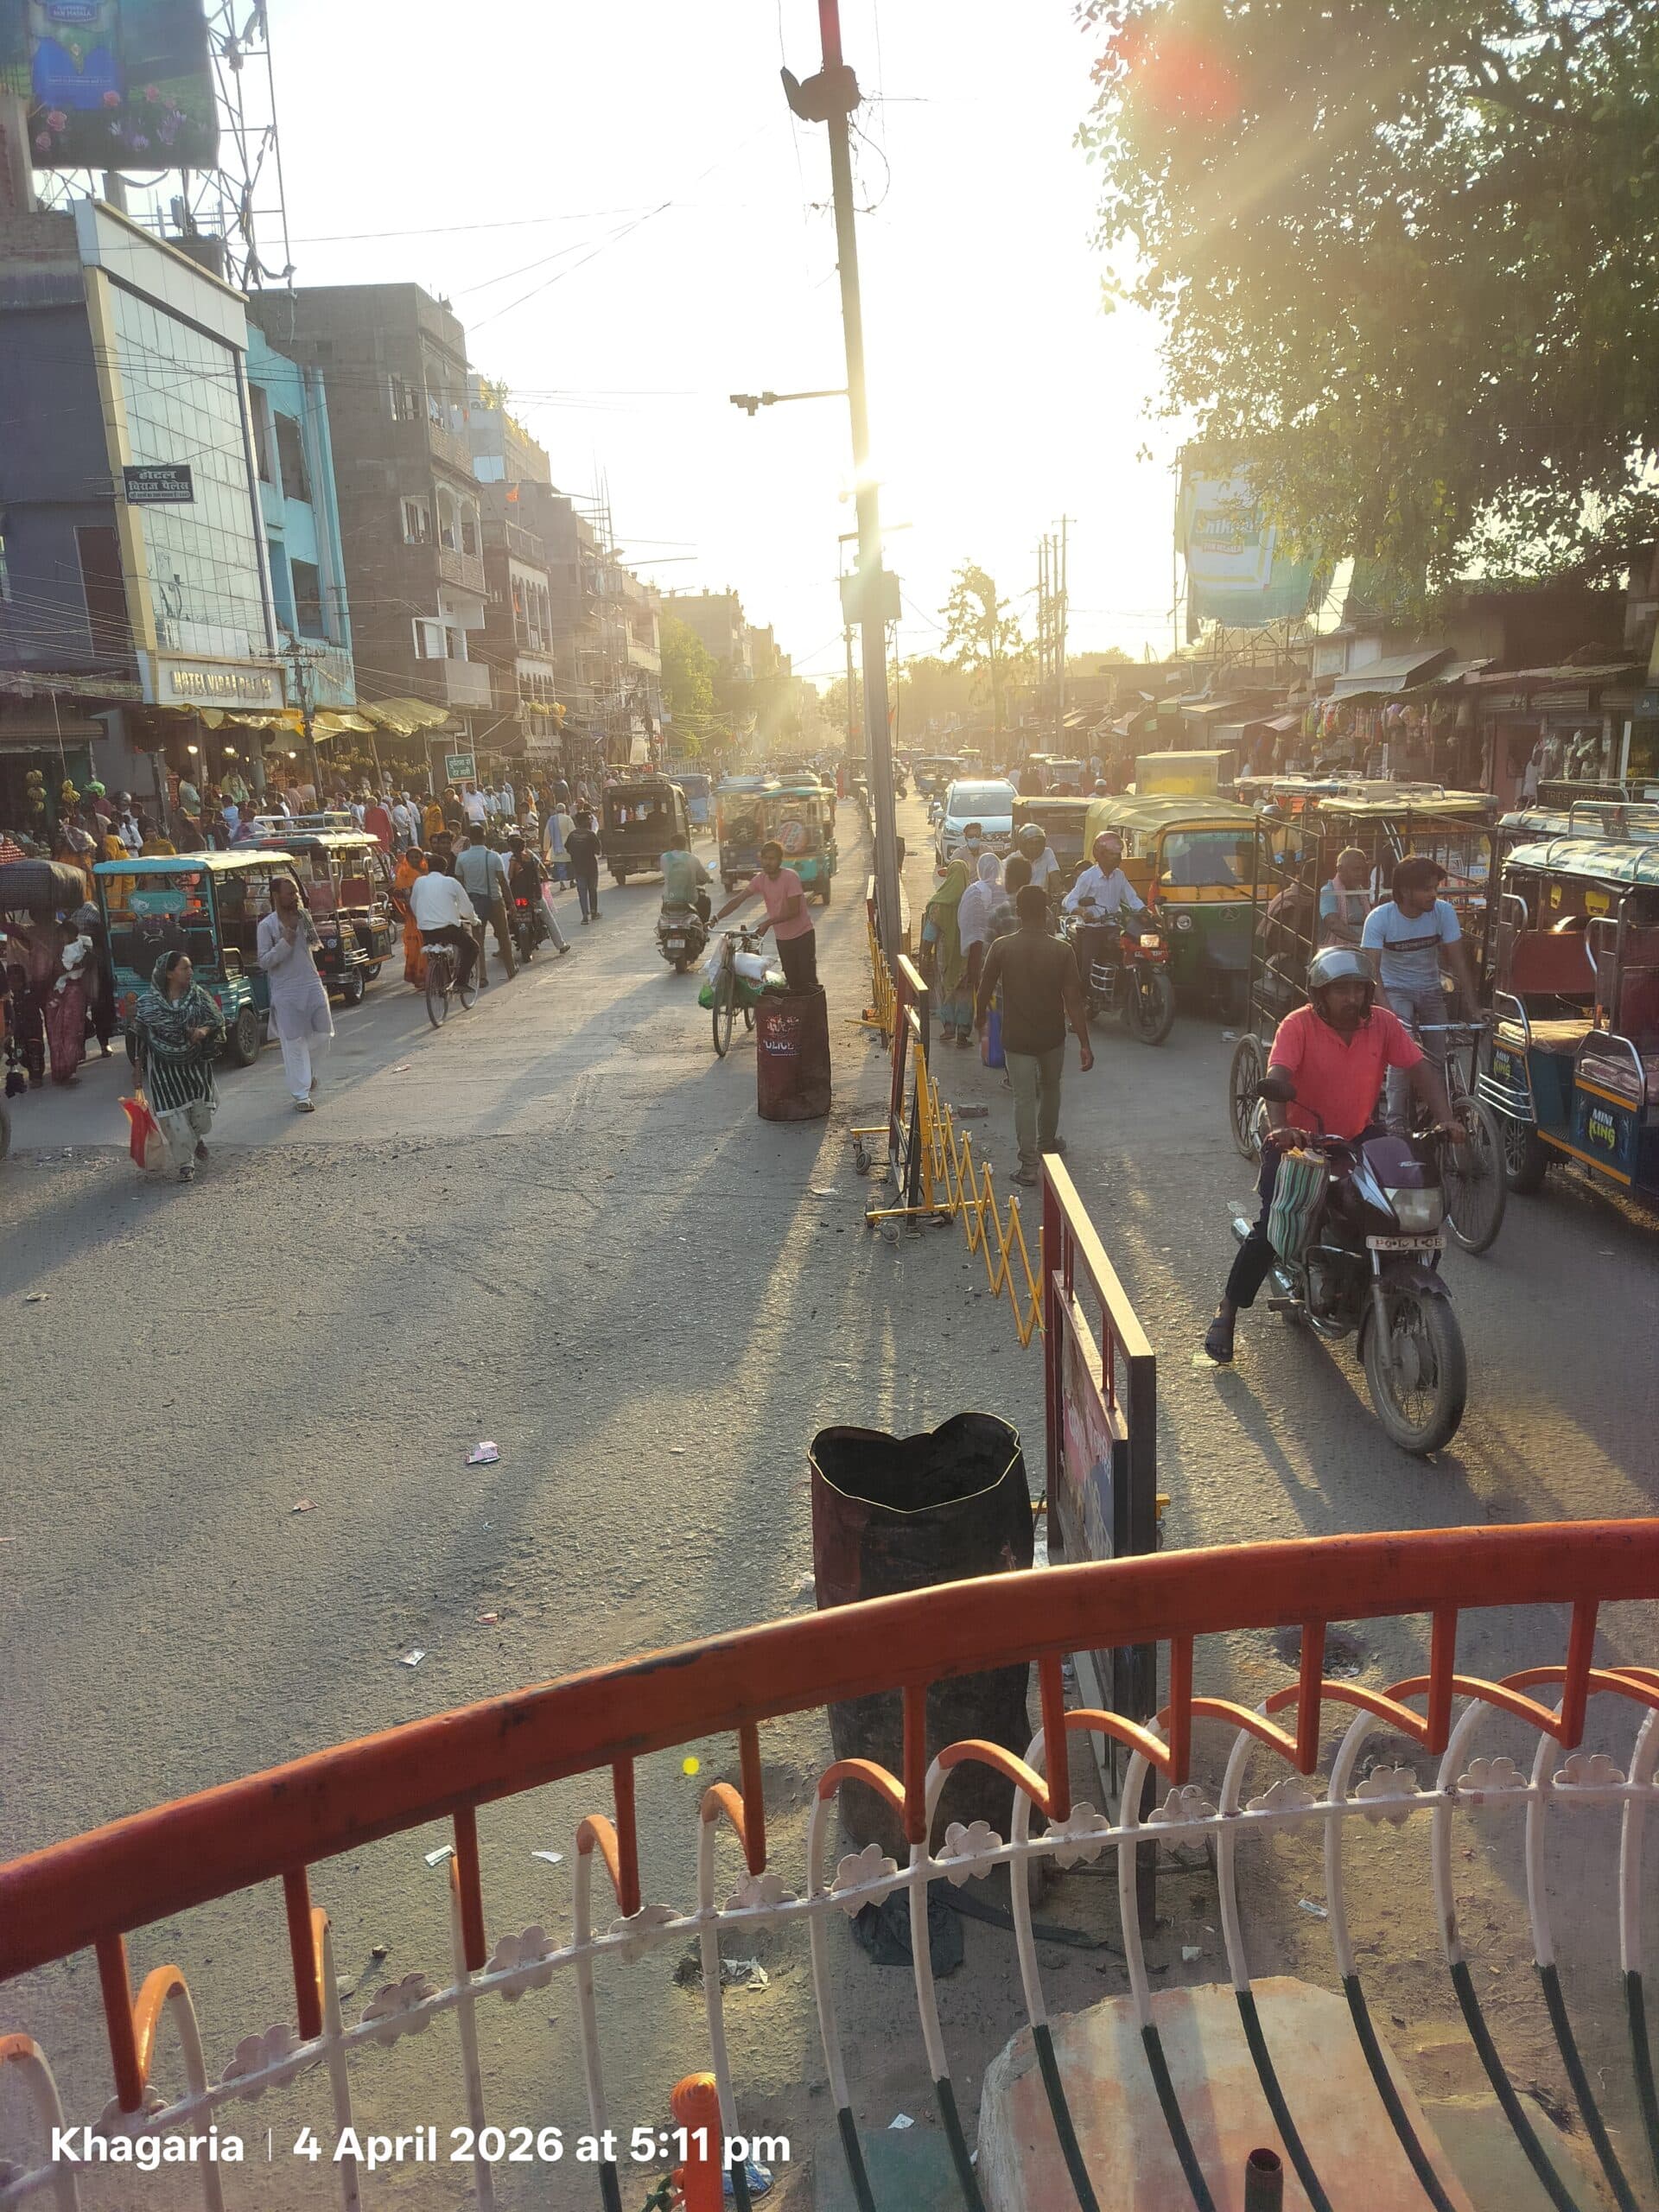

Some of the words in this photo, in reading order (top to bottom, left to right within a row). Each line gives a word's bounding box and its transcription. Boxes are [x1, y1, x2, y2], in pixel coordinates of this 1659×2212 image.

[138, 469, 177, 480] होटल
[1592, 1108, 1614, 1128] MINI
[1589, 1117, 1616, 1150] KING
